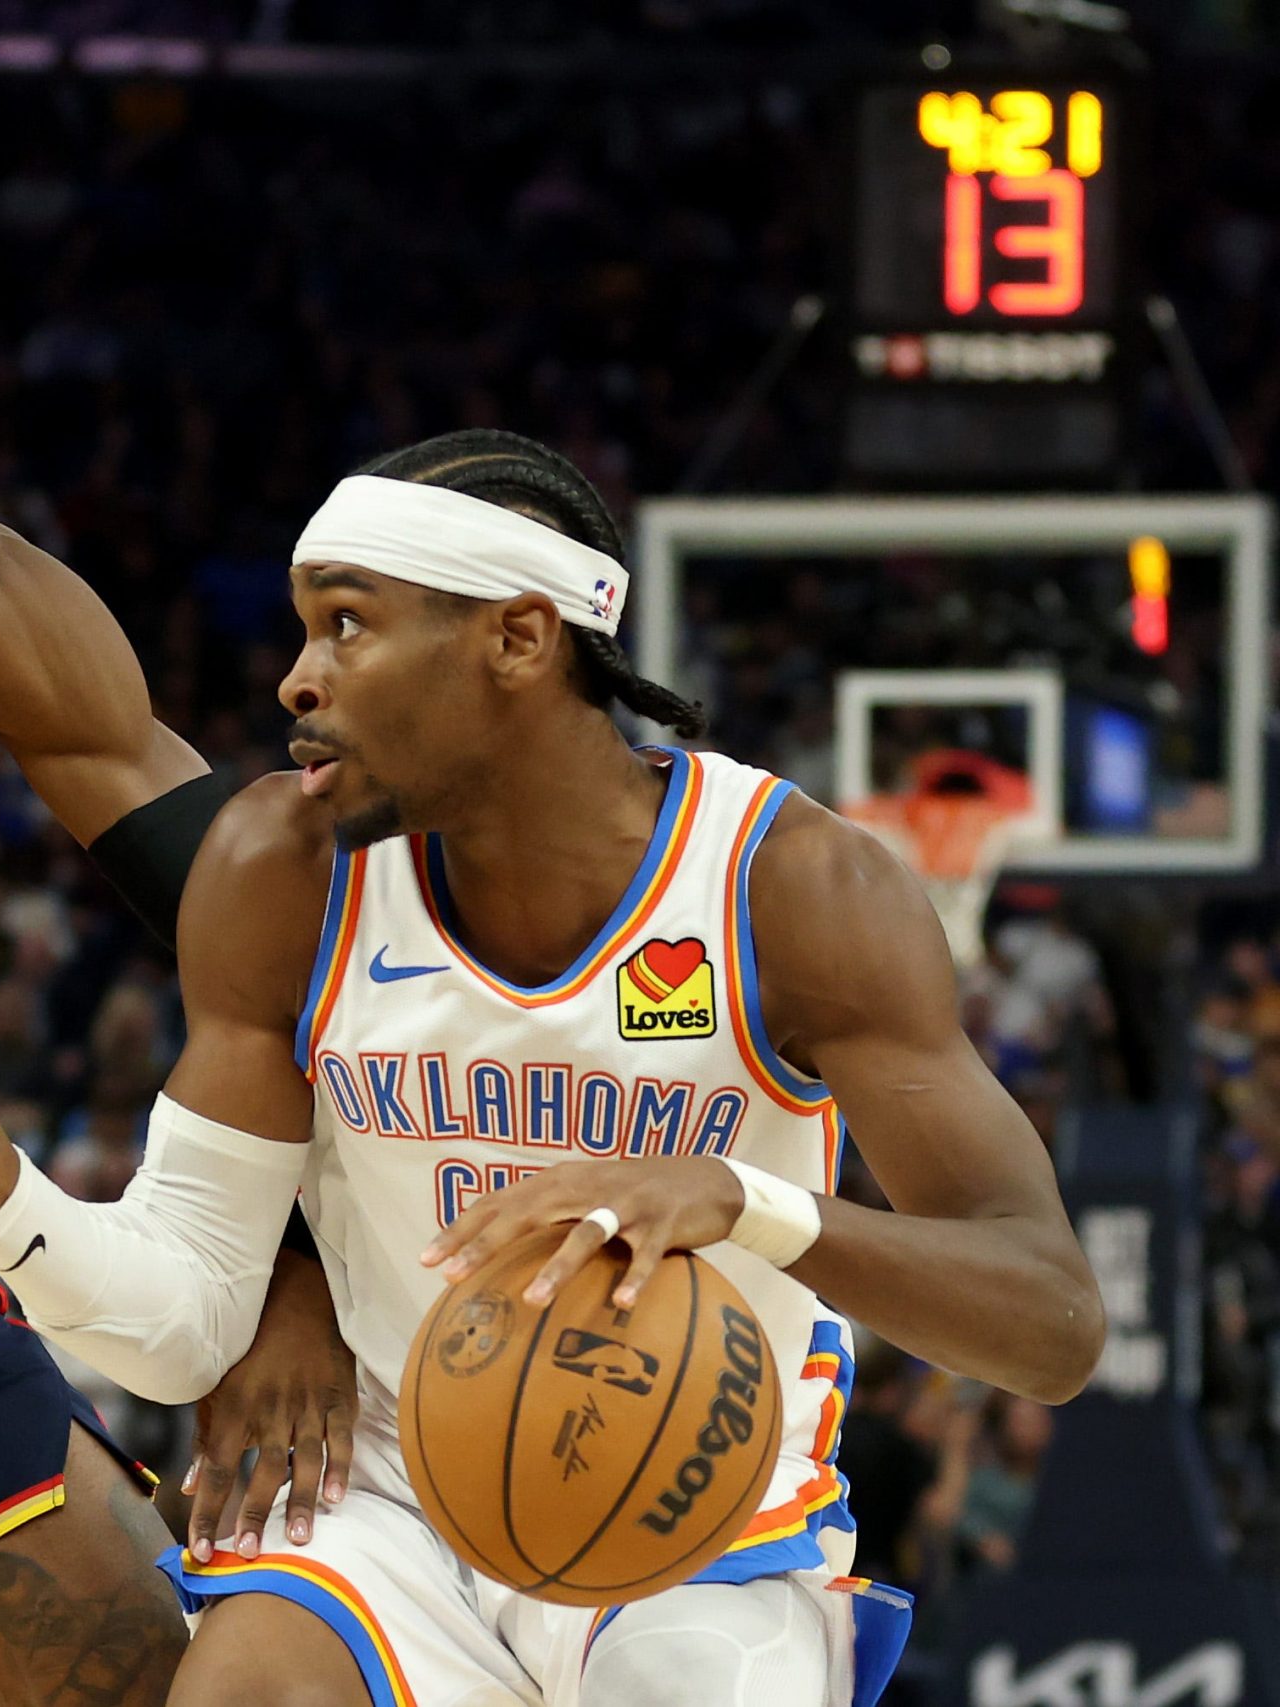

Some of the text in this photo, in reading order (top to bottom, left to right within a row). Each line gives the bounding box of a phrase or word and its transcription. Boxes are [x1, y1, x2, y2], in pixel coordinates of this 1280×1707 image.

[944, 169, 1084, 316] 13
[318, 1049, 749, 1160] OKLAHOMA
[637, 1304, 763, 1536] Wilson
